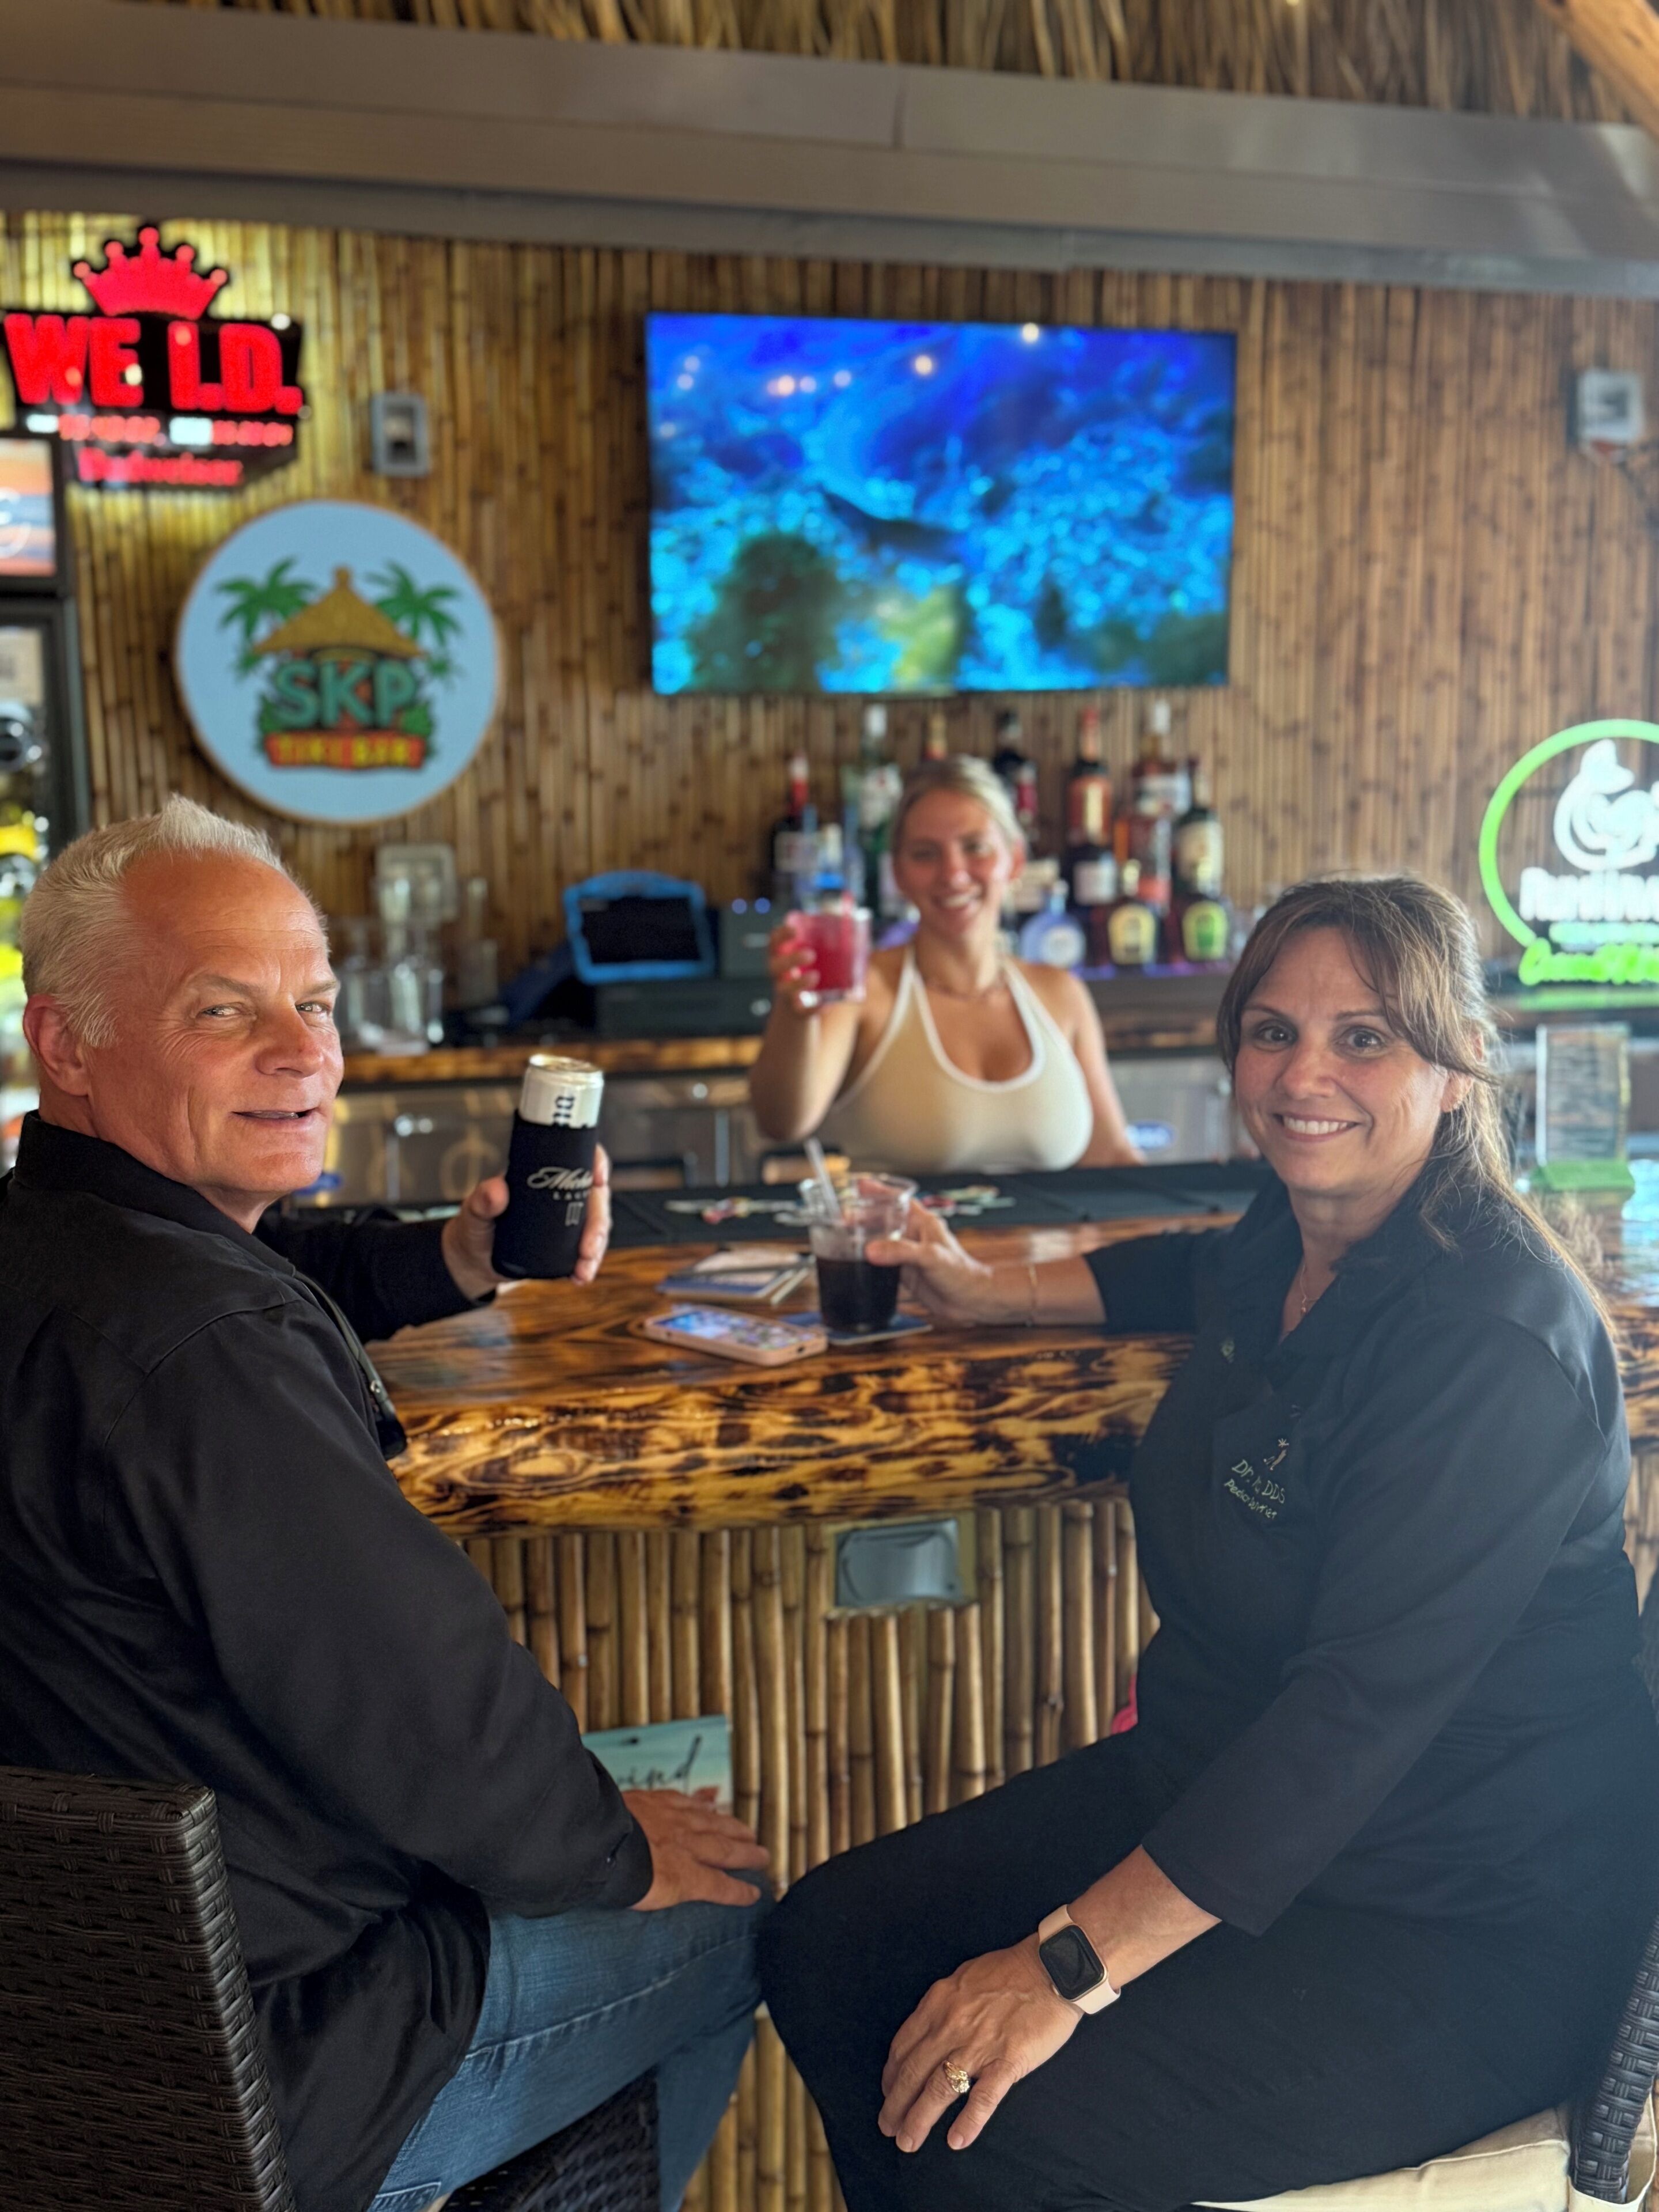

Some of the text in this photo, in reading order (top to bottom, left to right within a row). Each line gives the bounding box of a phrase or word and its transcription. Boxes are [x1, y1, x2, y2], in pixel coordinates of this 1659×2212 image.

[4, 314, 304, 415] WE I.D.
[273, 659, 419, 729] SKP
[1232, 1459, 1254, 1483] Dr.
[1261, 1480, 1285, 1504] DDS
